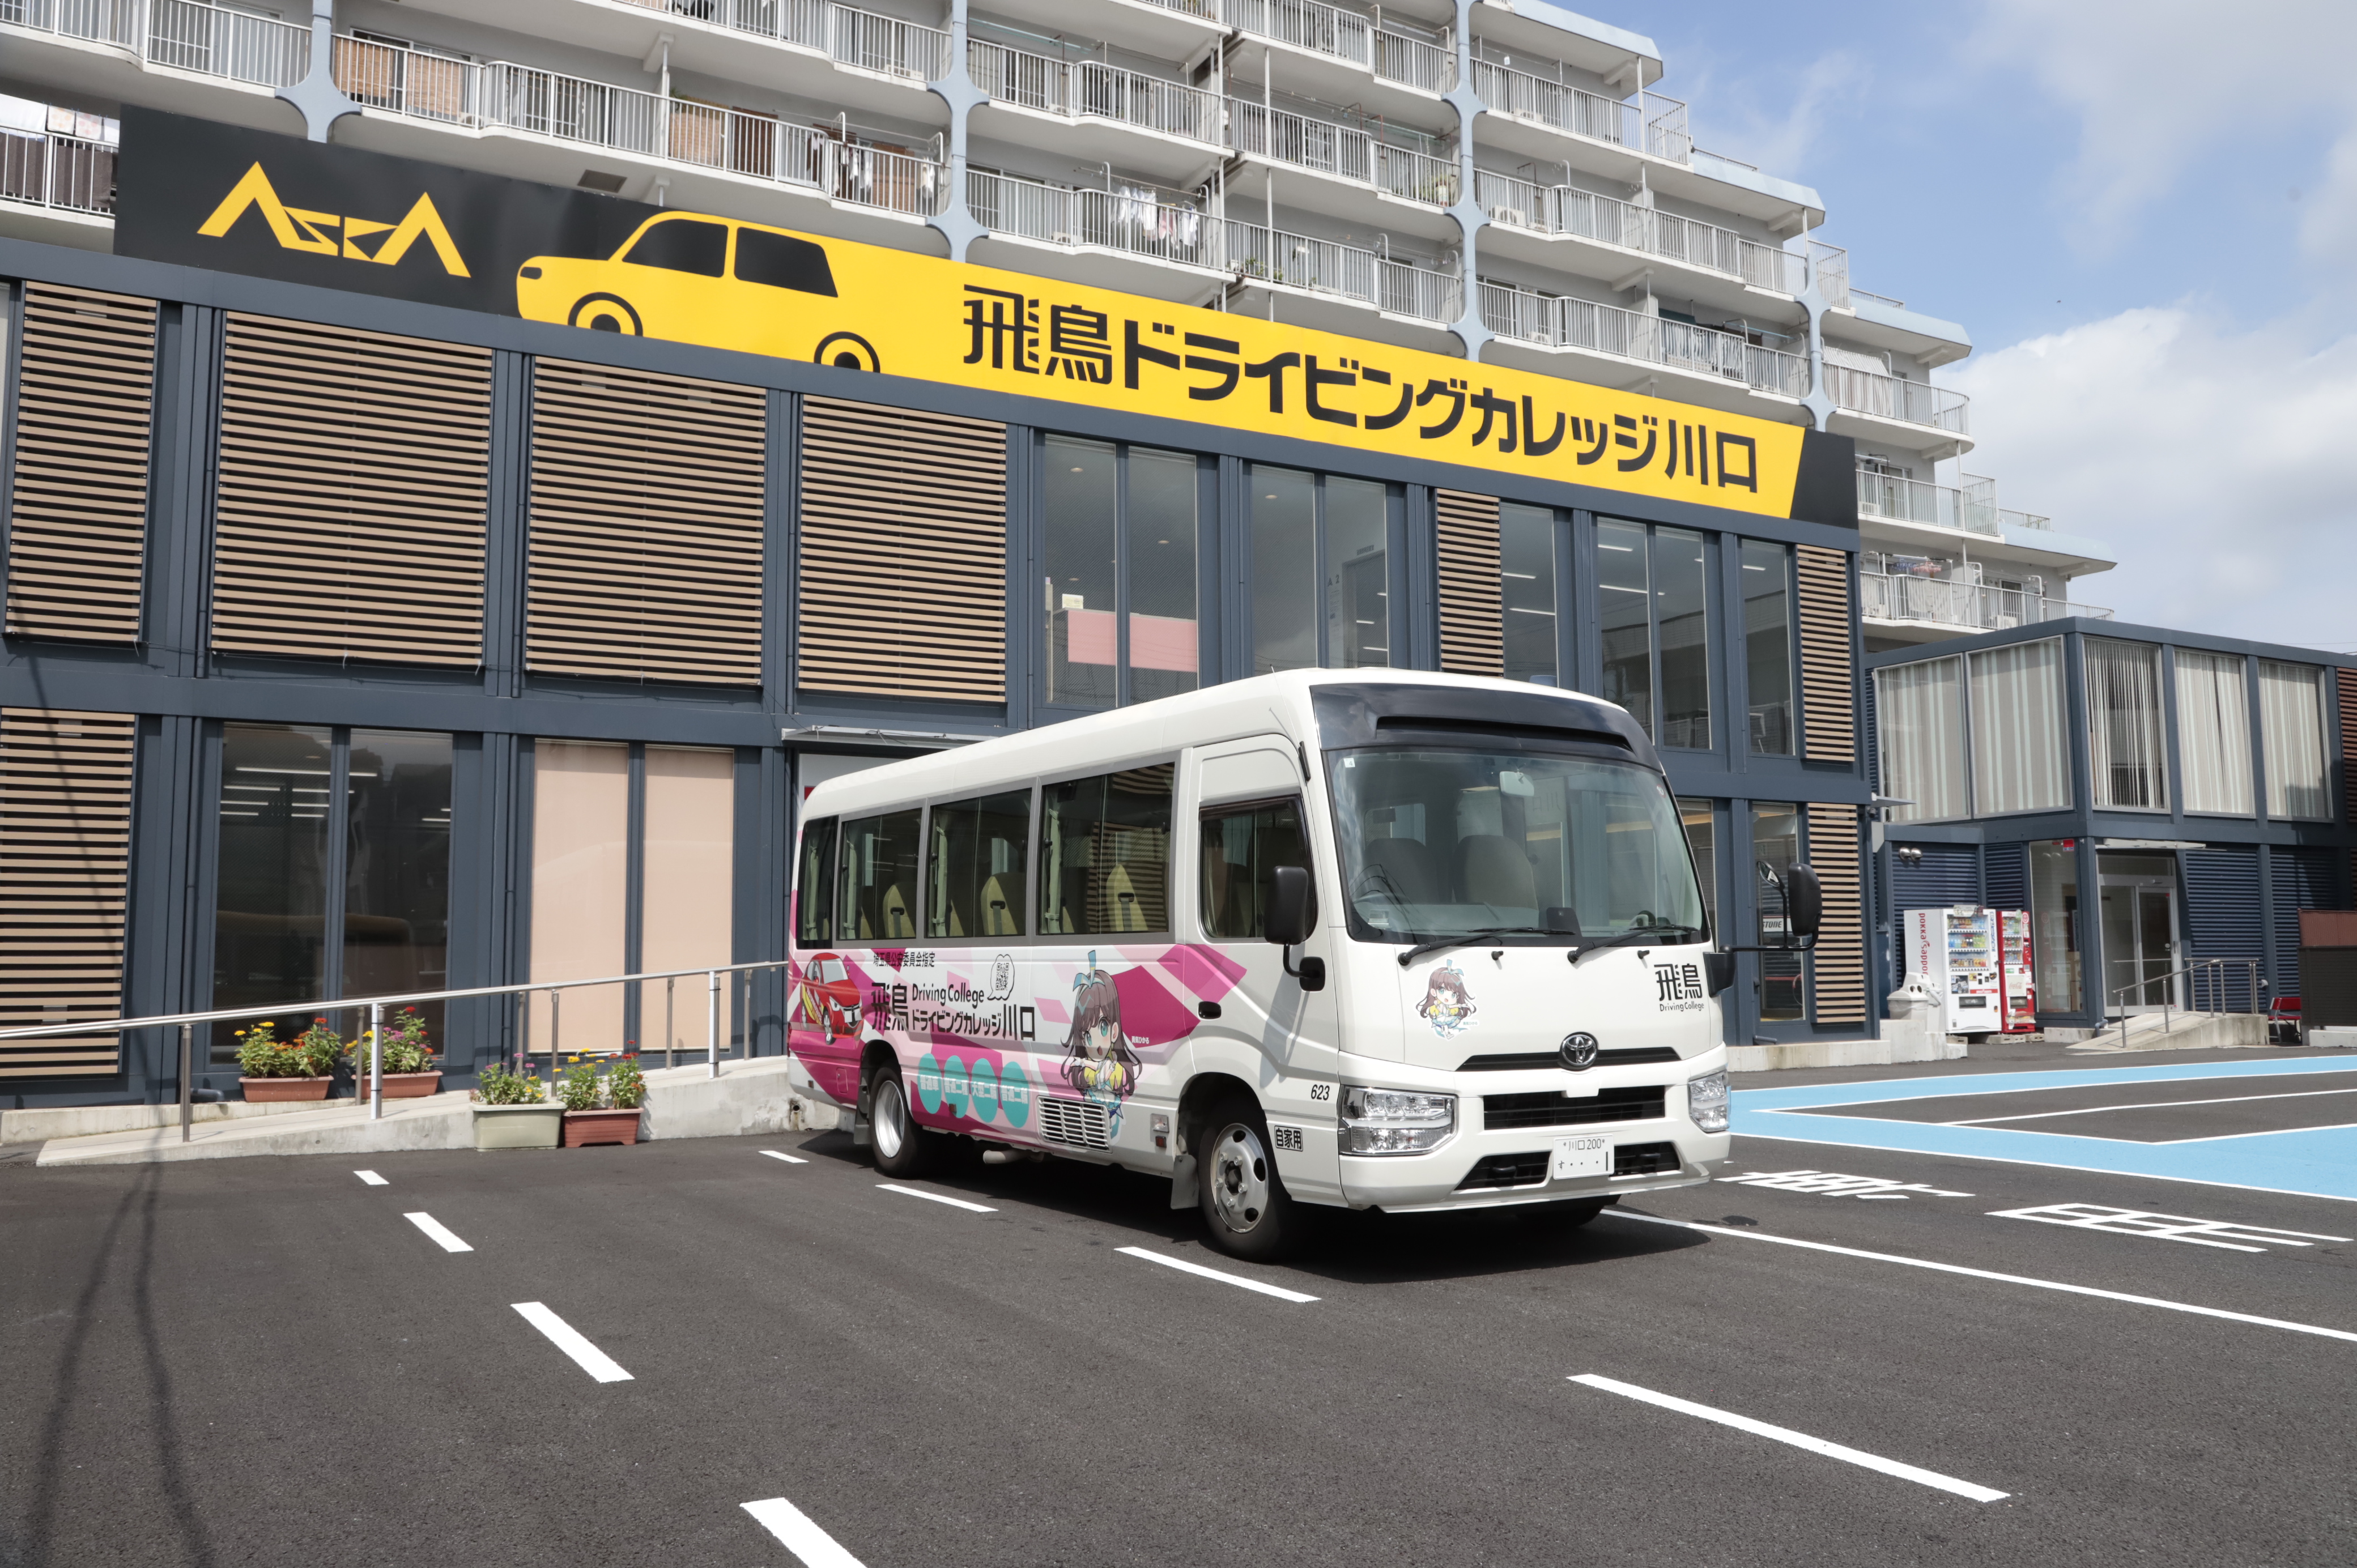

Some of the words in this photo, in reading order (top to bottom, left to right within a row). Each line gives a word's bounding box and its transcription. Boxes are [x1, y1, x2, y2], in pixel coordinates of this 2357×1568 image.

[963, 284, 1758, 493] 飛鳥ドライビングカレッジ川口
[873, 952, 935, 968] 埼玉県公安委員会指定
[1653, 963, 1703, 1002] 飛鳥
[871, 982, 909, 1032] 飛鳥
[912, 983, 946, 1007] Driving
[948, 982, 985, 1009] College
[1660, 1003, 1684, 1012] Driving
[1684, 1001, 1704, 1011] College
[912, 1004, 1036, 1041] ドライビングカレッジ川口
[920, 1074, 939, 1092] 普通車
[1311, 1084, 1330, 1101] 623
[1276, 1128, 1302, 1150] 自家用
[1569, 1140, 1585, 1151] 川口
[1587, 1139, 1601, 1150] 200
[1713, 1170, 2356, 1252] 専用
